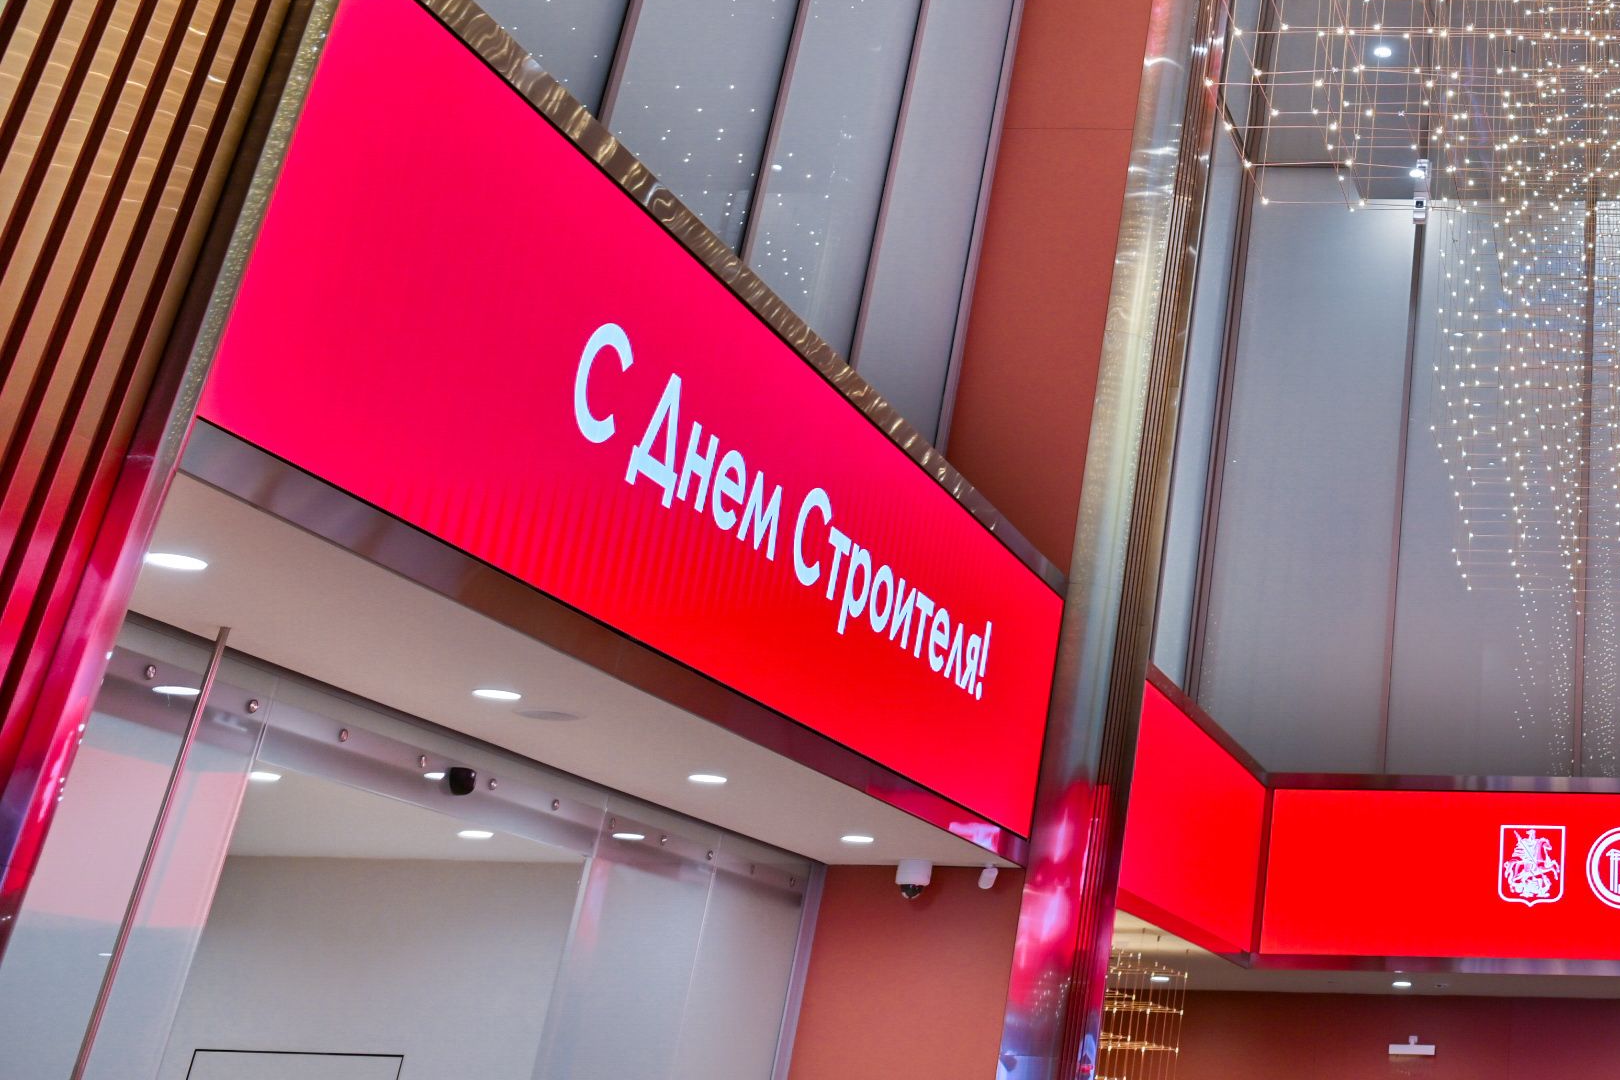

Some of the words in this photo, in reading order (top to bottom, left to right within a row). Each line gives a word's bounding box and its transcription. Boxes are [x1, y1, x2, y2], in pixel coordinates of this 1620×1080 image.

[574, 322, 634, 444] С
[624, 372, 783, 562] Днем
[793, 486, 993, 701] Строителя!
